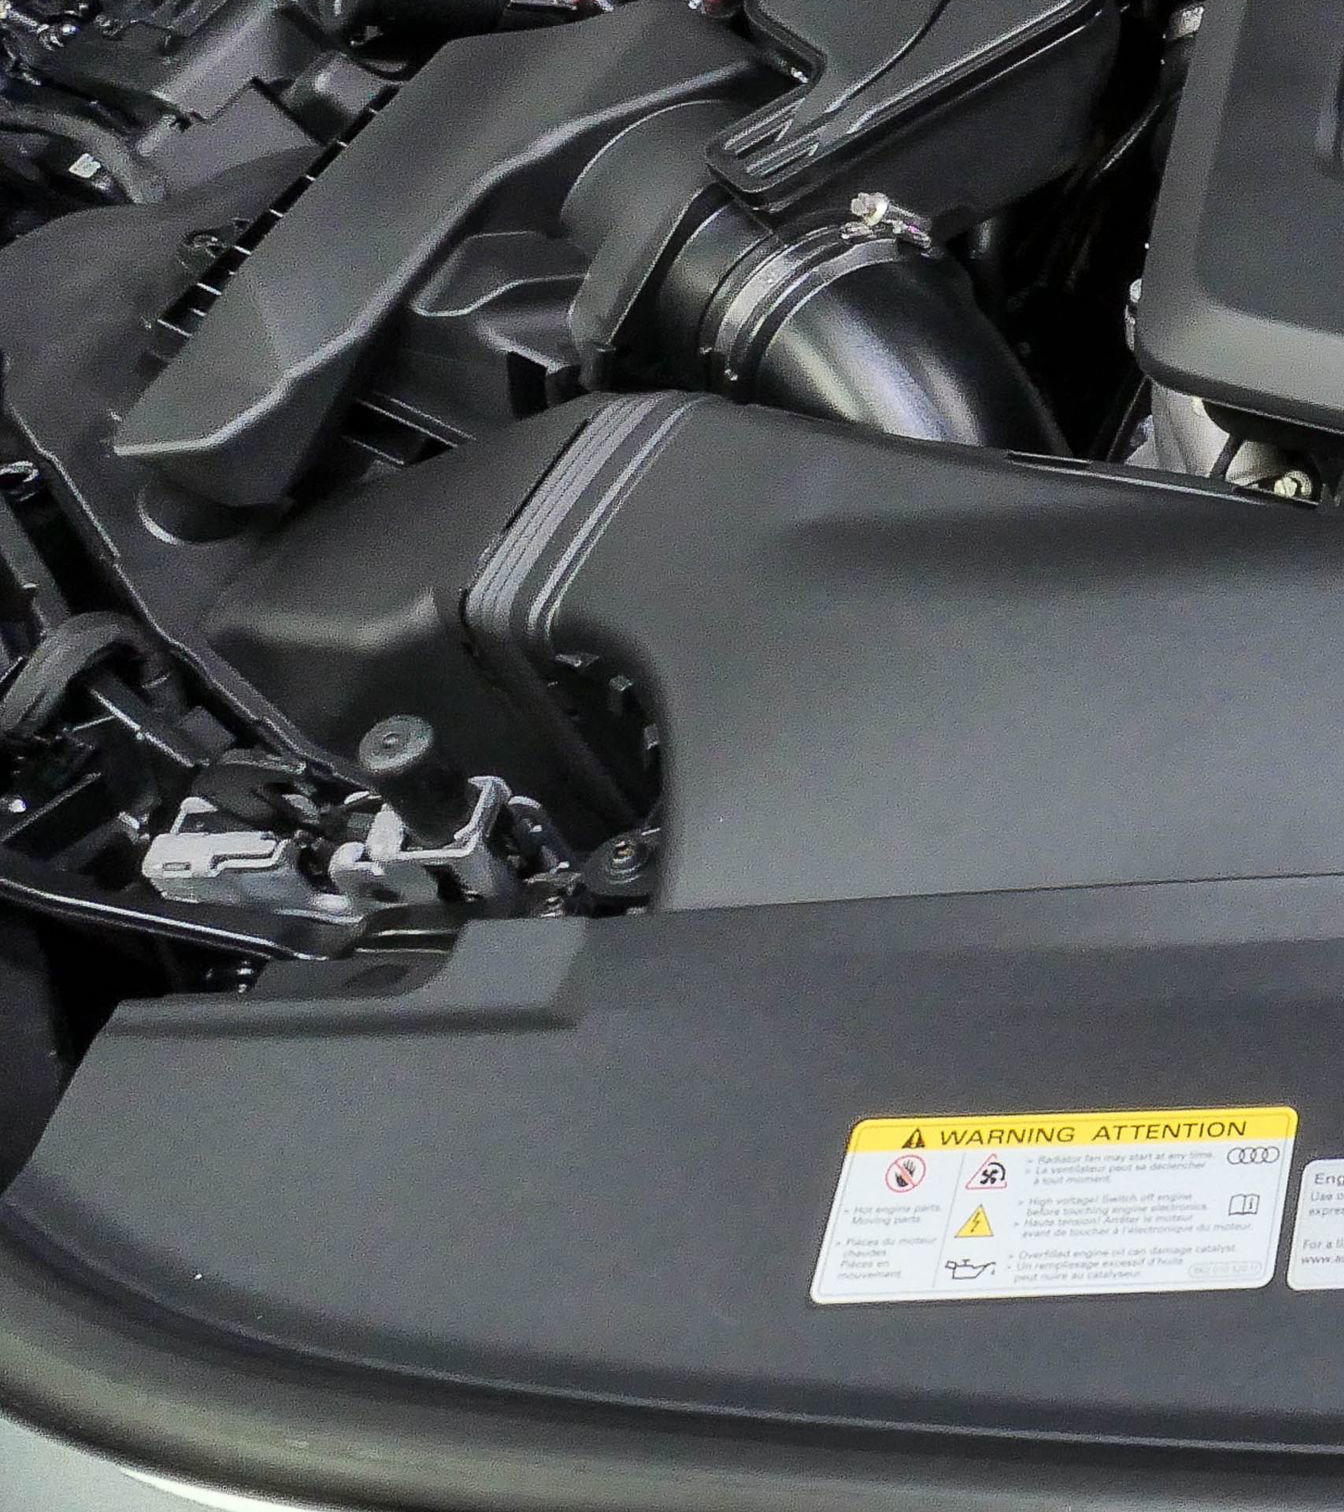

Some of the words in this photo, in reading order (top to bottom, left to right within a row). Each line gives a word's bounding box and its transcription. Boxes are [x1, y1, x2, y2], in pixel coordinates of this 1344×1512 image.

[940, 1128, 1075, 1145] WARNING
[1092, 1122, 1247, 1141] ATTENTION
[1310, 1192, 1333, 1202] Use
[1303, 1238, 1322, 1249] For
[1326, 1240, 1332, 1249] a
